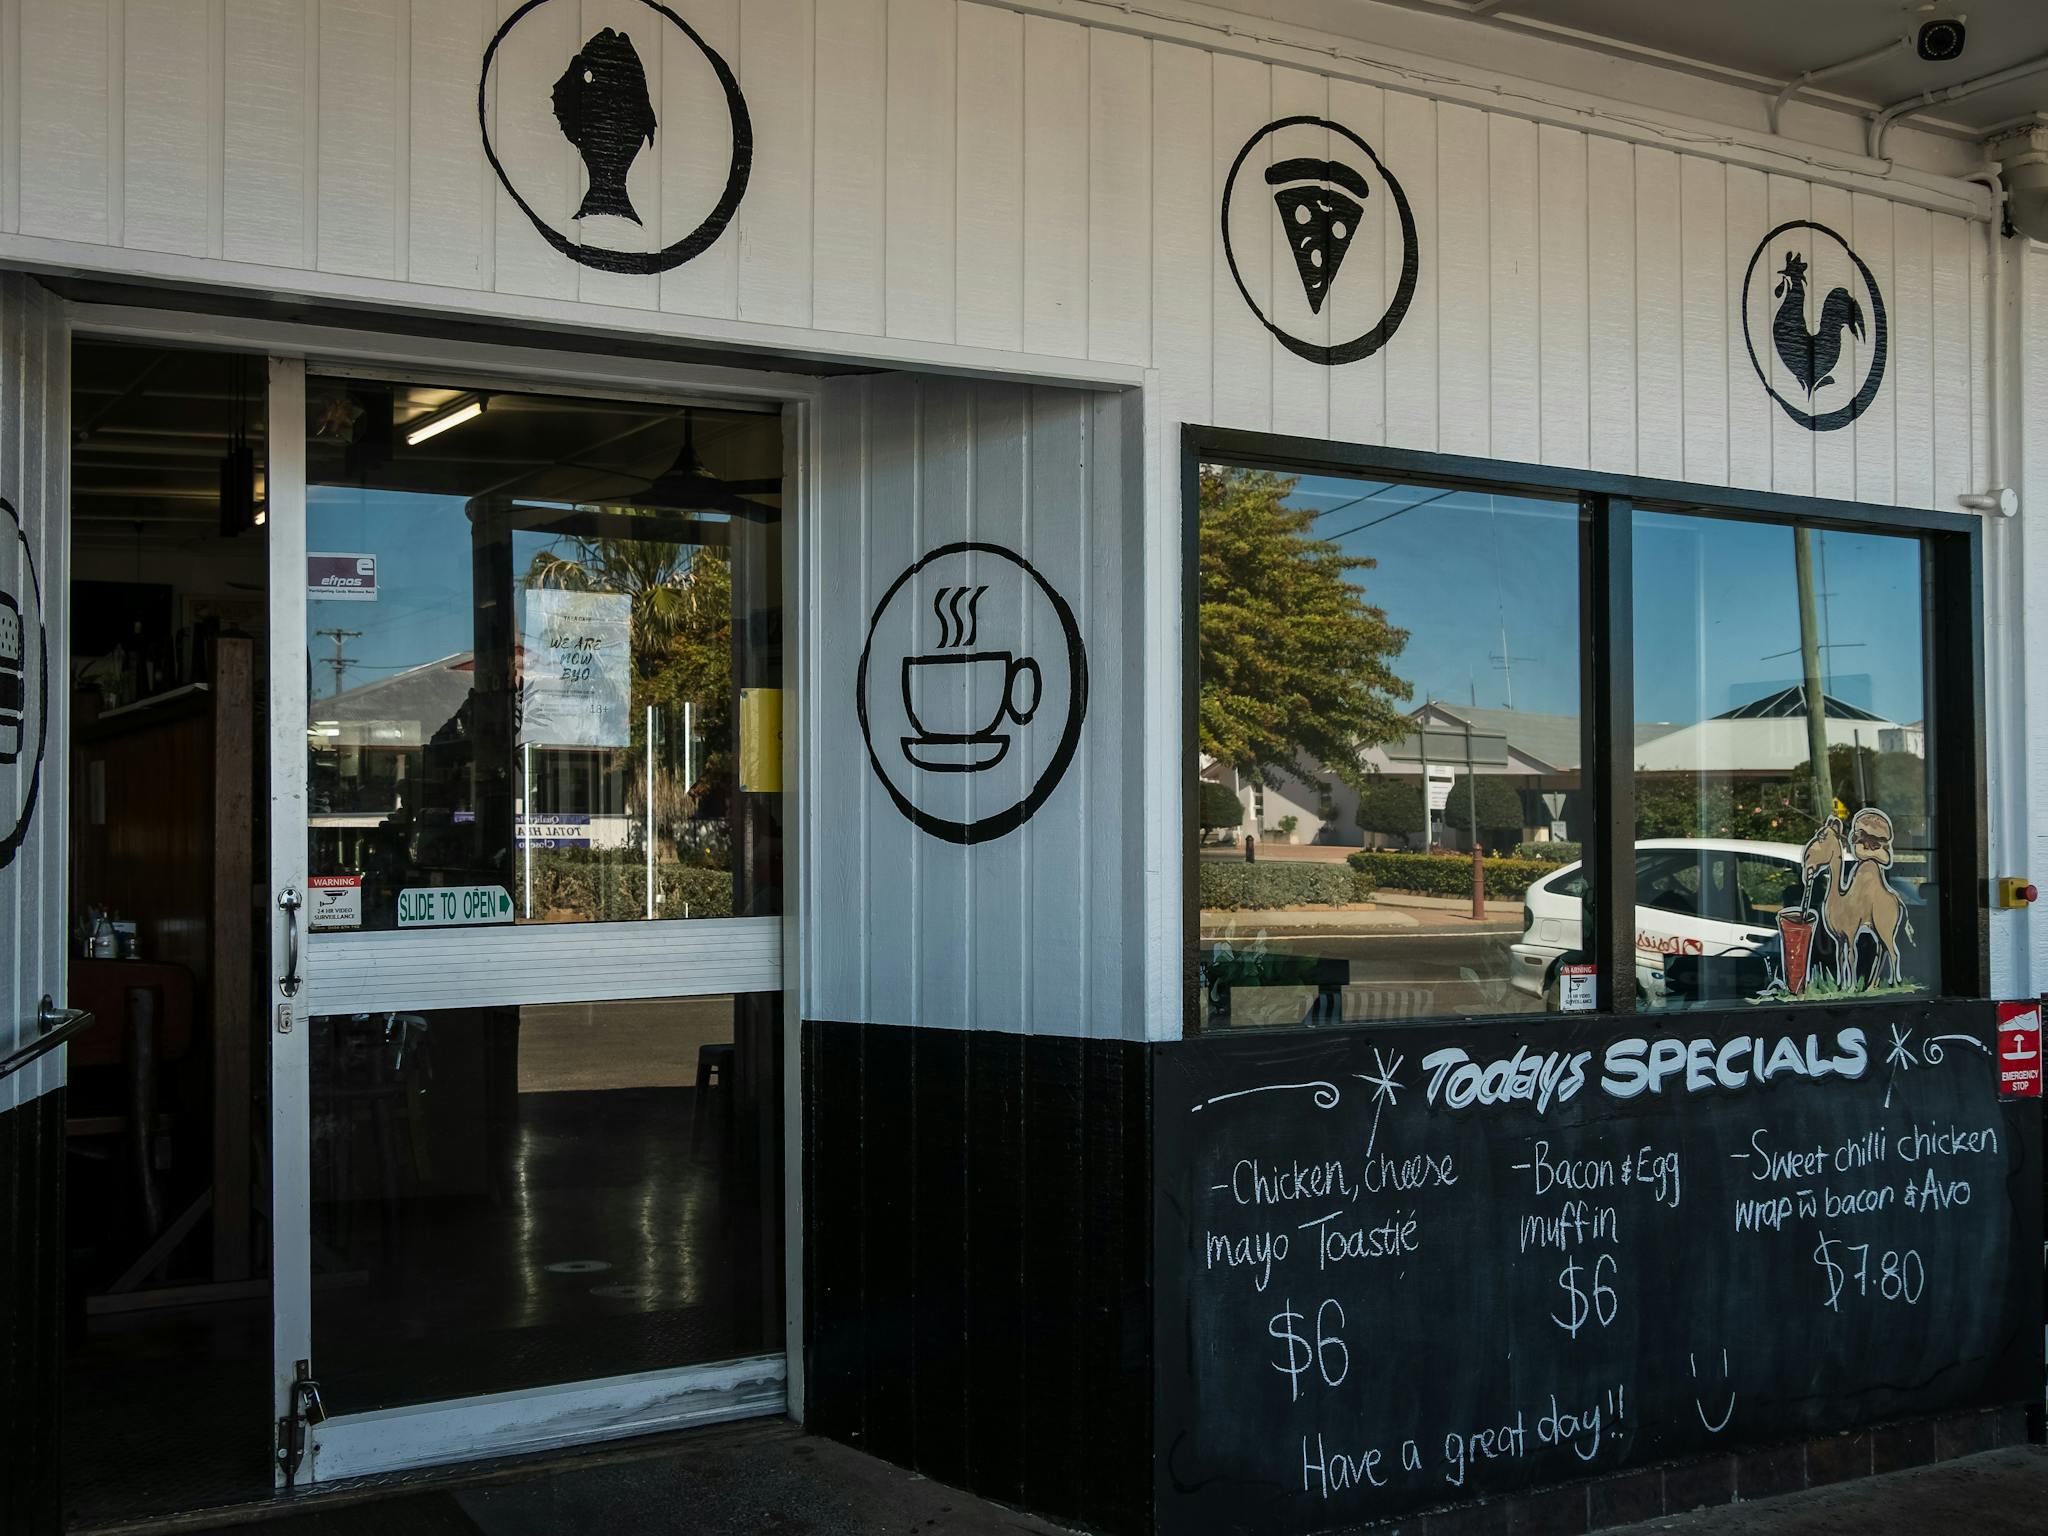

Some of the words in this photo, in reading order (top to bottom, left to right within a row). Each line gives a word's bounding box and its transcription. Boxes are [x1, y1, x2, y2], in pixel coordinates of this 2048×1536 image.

[321, 574, 363, 588] eftpos
[550, 636, 570, 649] WE
[574, 636, 602, 651] ARE
[560, 653, 593, 665] NOW
[559, 667, 590, 682] BYO
[313, 877, 355, 887] WARNING
[314, 913, 355, 921] SURVEILLANCE
[399, 893, 435, 922] SLIDE
[440, 891, 457, 920] TO
[463, 890, 496, 919] OPEN
[1421, 1045, 1593, 1115] Todays
[1601, 1027, 1869, 1099] SPECIALS
[2001, 1069, 2040, 1082] EMERGENCY
[2012, 1080, 2030, 1091] STOP
[1834, 1126, 1887, 1173] chilli
[1897, 1120, 1998, 1162] chicken
[1364, 1152, 1459, 1193] cheese
[1520, 1199, 1620, 1254] muffin
[1735, 1196, 1794, 1233] wrap
[1825, 1186, 1896, 1218] bacon
[1206, 1230, 1290, 1292] mayo
[1813, 1230, 1925, 1313] $7.80
[1550, 1253, 1618, 1339] $6
[1268, 1298, 1350, 1402] $6
[1302, 1431, 1389, 1500] Have
[1402, 1440, 1424, 1472] a
[1444, 1410, 1529, 1487] great
